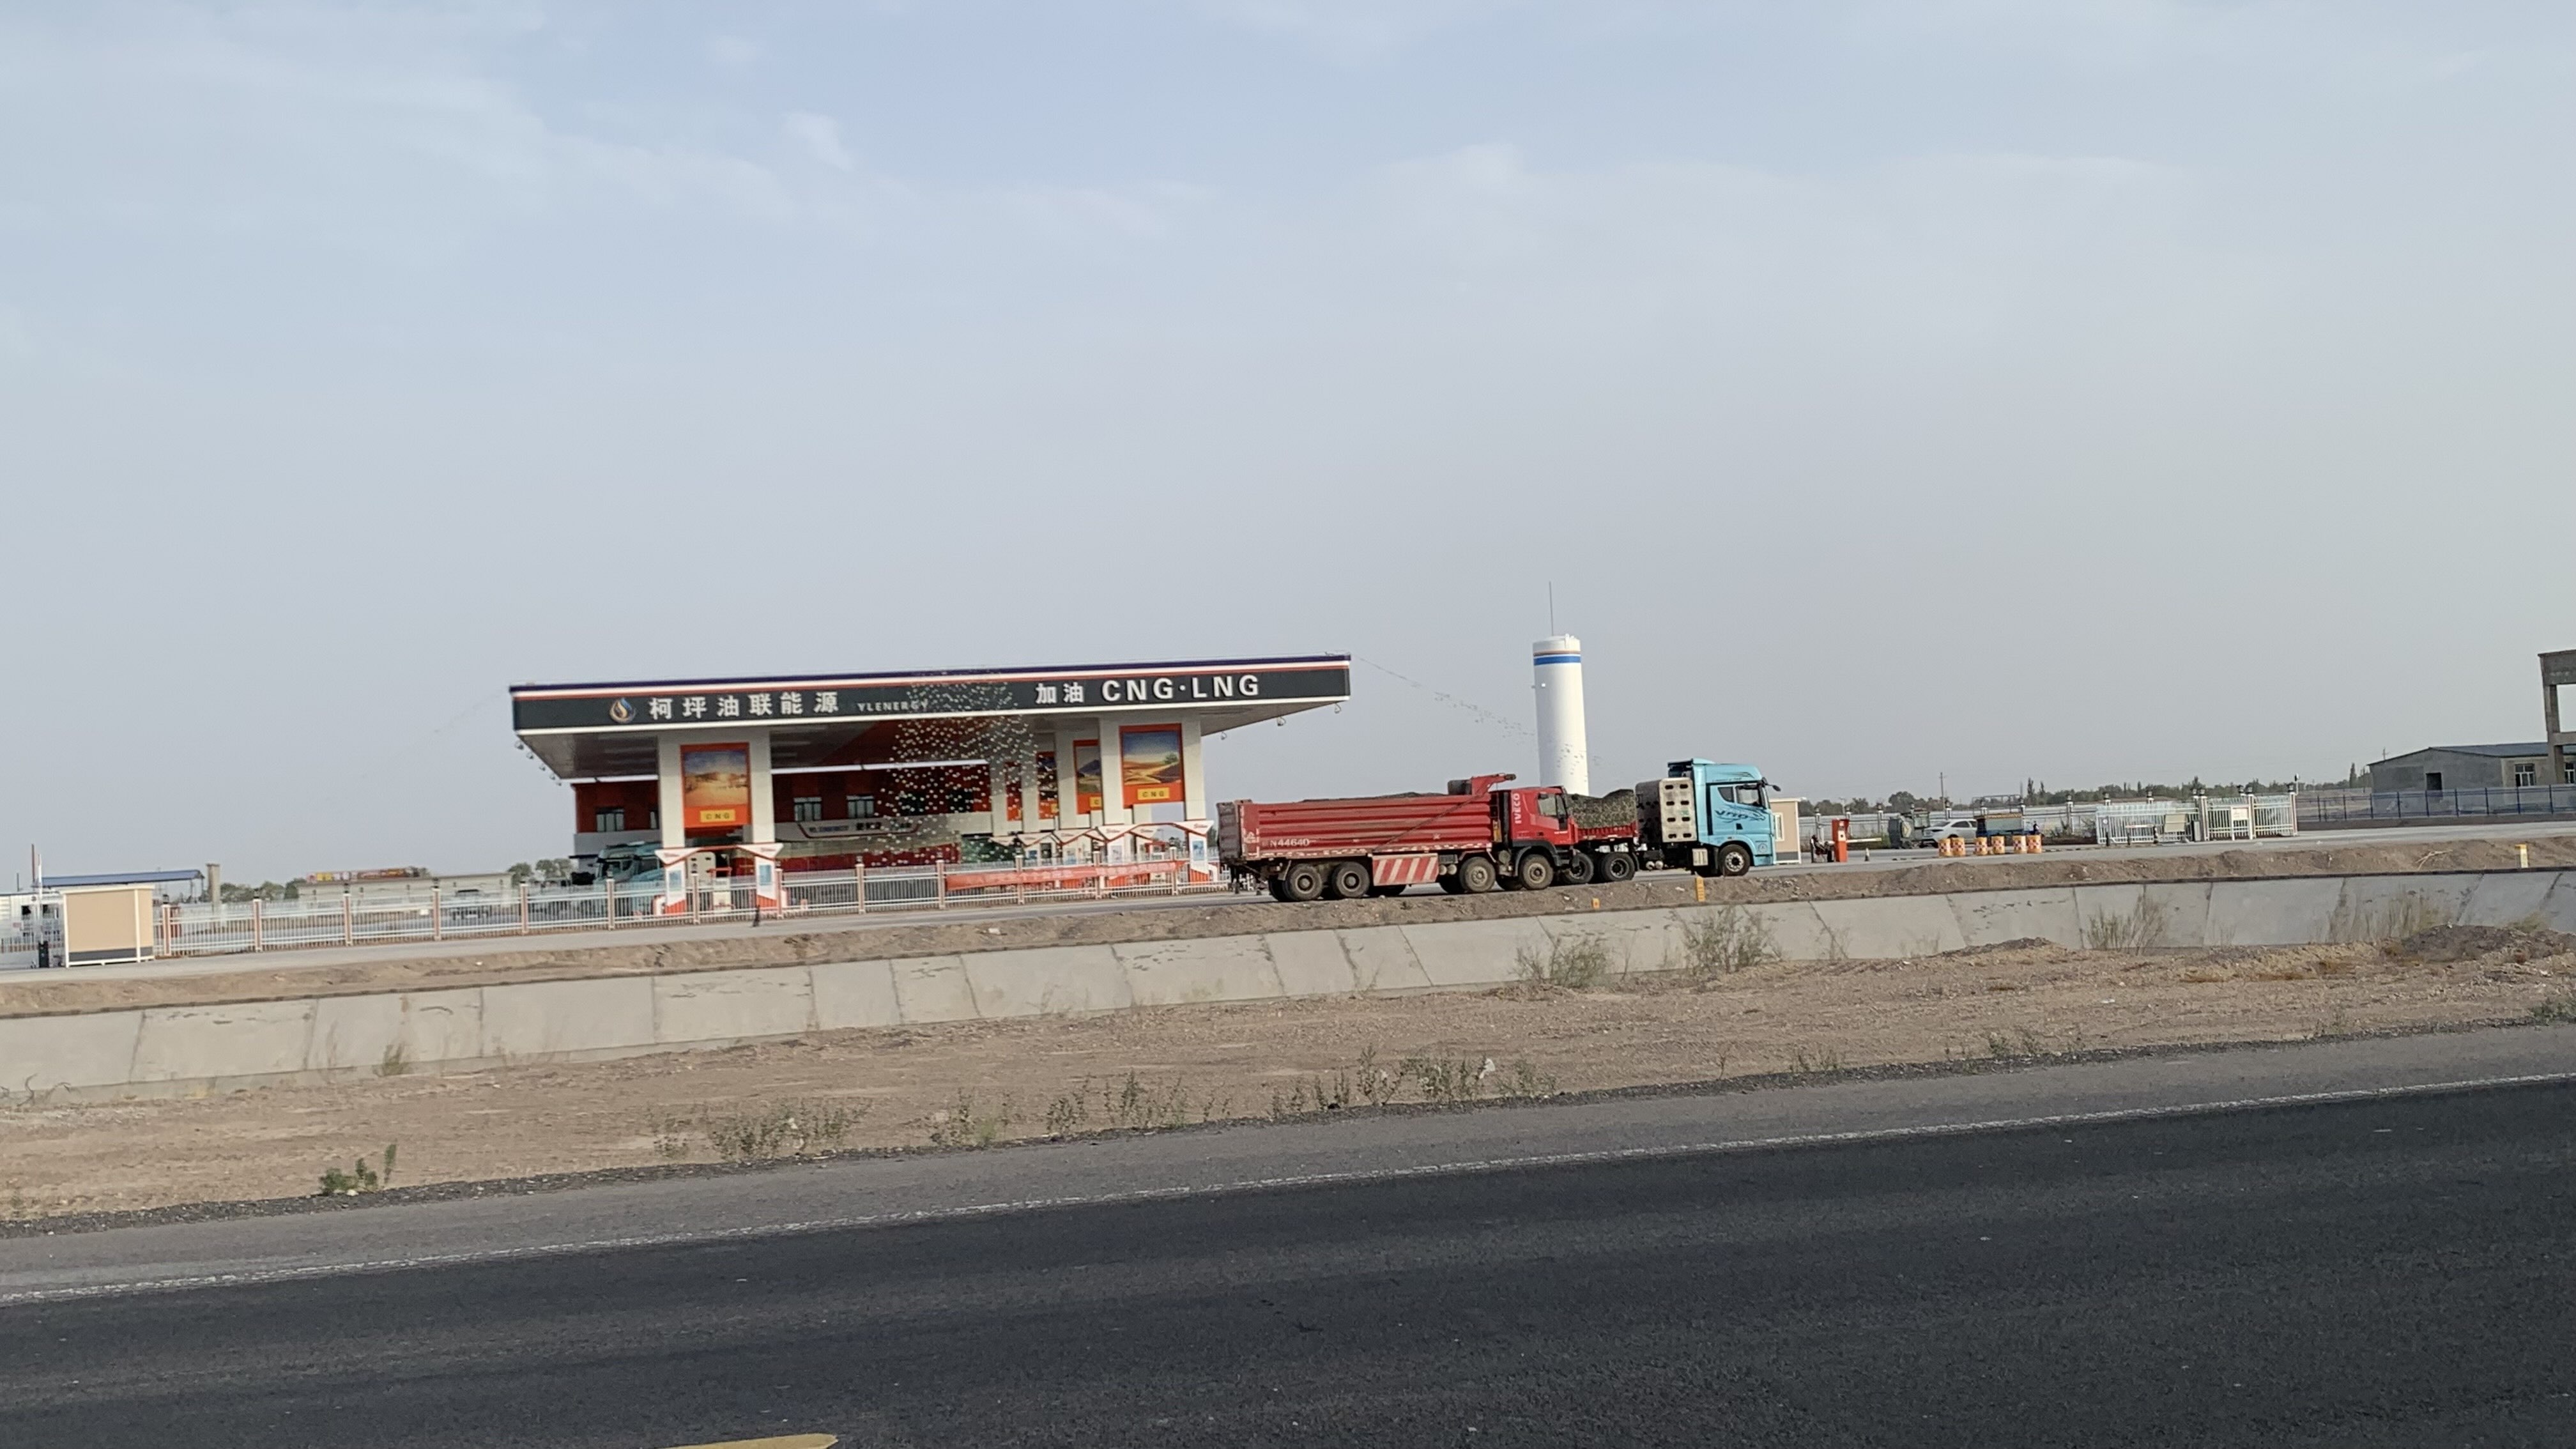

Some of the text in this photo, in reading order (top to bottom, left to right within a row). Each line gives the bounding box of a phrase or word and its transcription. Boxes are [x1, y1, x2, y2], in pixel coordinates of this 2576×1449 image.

[1035, 682, 1084, 703] 加油
[649, 691, 839, 719] 柯坪油联能源
[1513, 793, 1522, 824] IVECO
[1261, 838, 1310, 848] N44640
